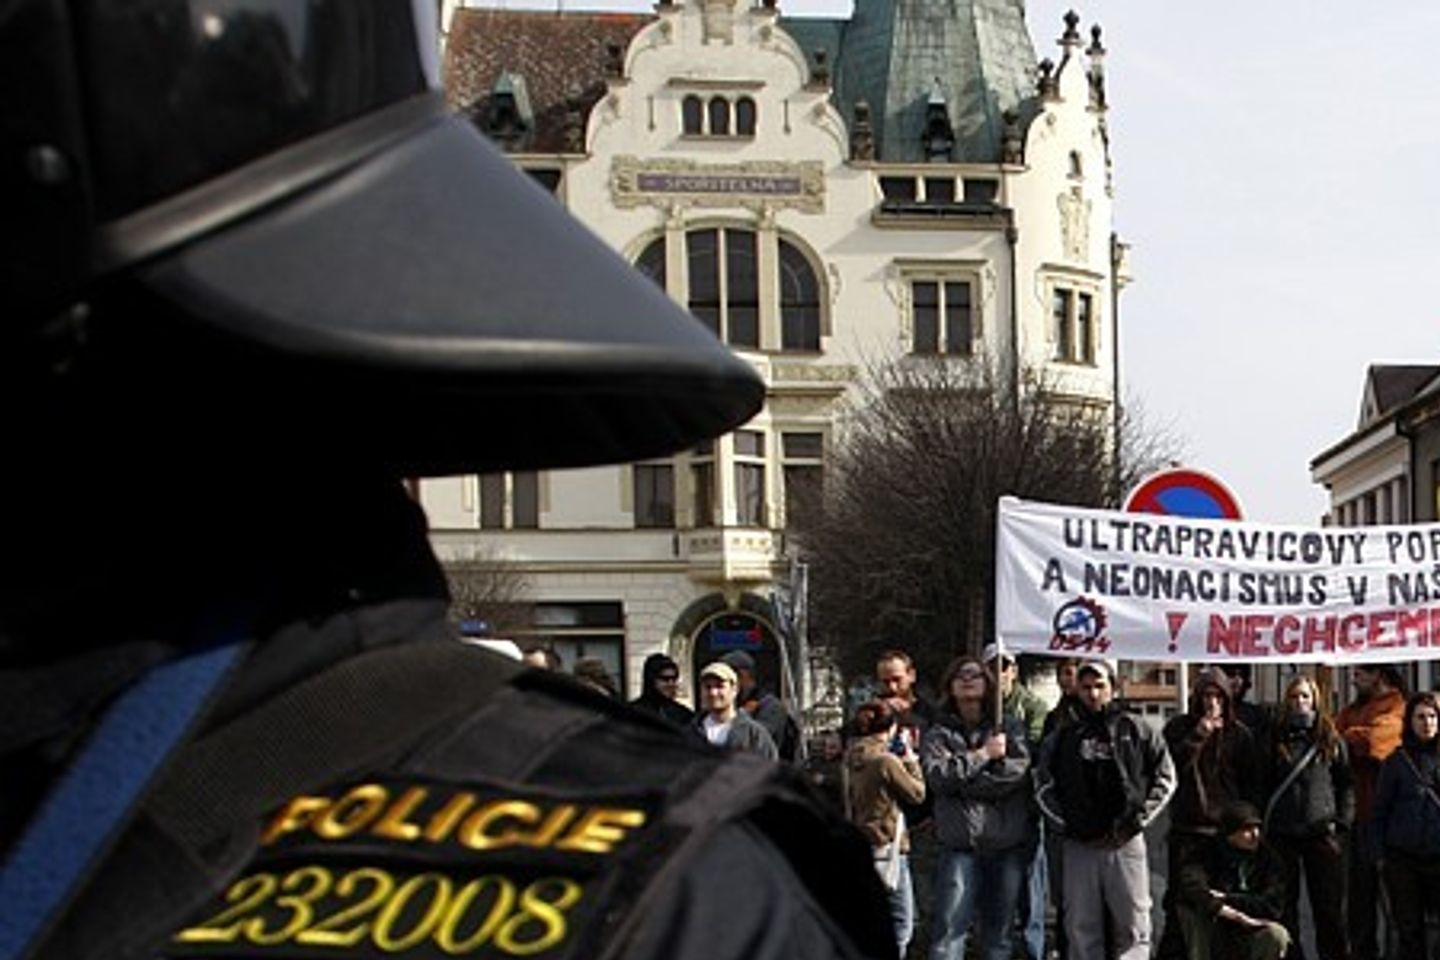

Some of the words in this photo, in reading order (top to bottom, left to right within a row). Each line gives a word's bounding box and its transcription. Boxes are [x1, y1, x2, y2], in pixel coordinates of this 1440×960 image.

[1040, 557, 1068, 594] A
[1083, 562, 1327, 606] NEONACISMUS
[1347, 575, 1368, 606] V
[260, 783, 646, 854] POLICIE
[172, 865, 583, 956] 232008
